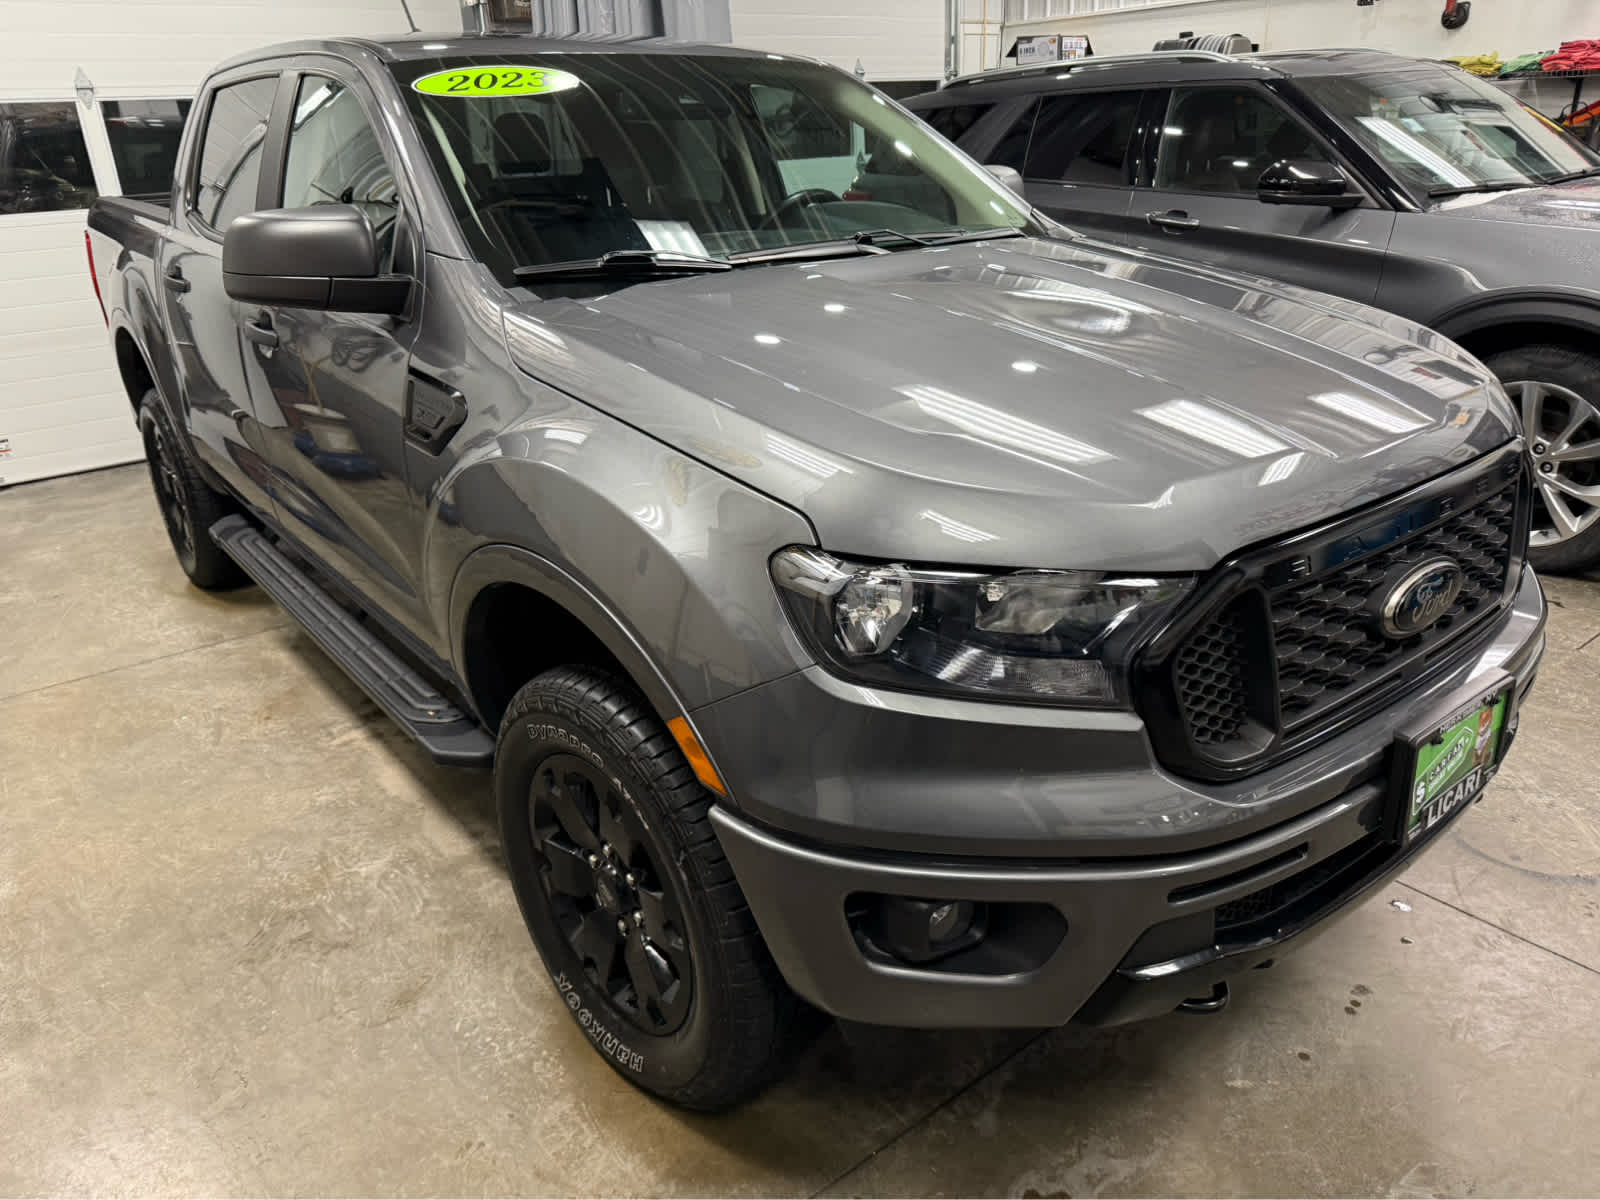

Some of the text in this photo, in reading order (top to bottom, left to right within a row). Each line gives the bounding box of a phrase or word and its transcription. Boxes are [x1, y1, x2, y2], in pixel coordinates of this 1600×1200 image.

[448, 72, 549, 92] 2023
[1412, 577, 1455, 624] Ford
[1426, 768, 1482, 828] LICARI
